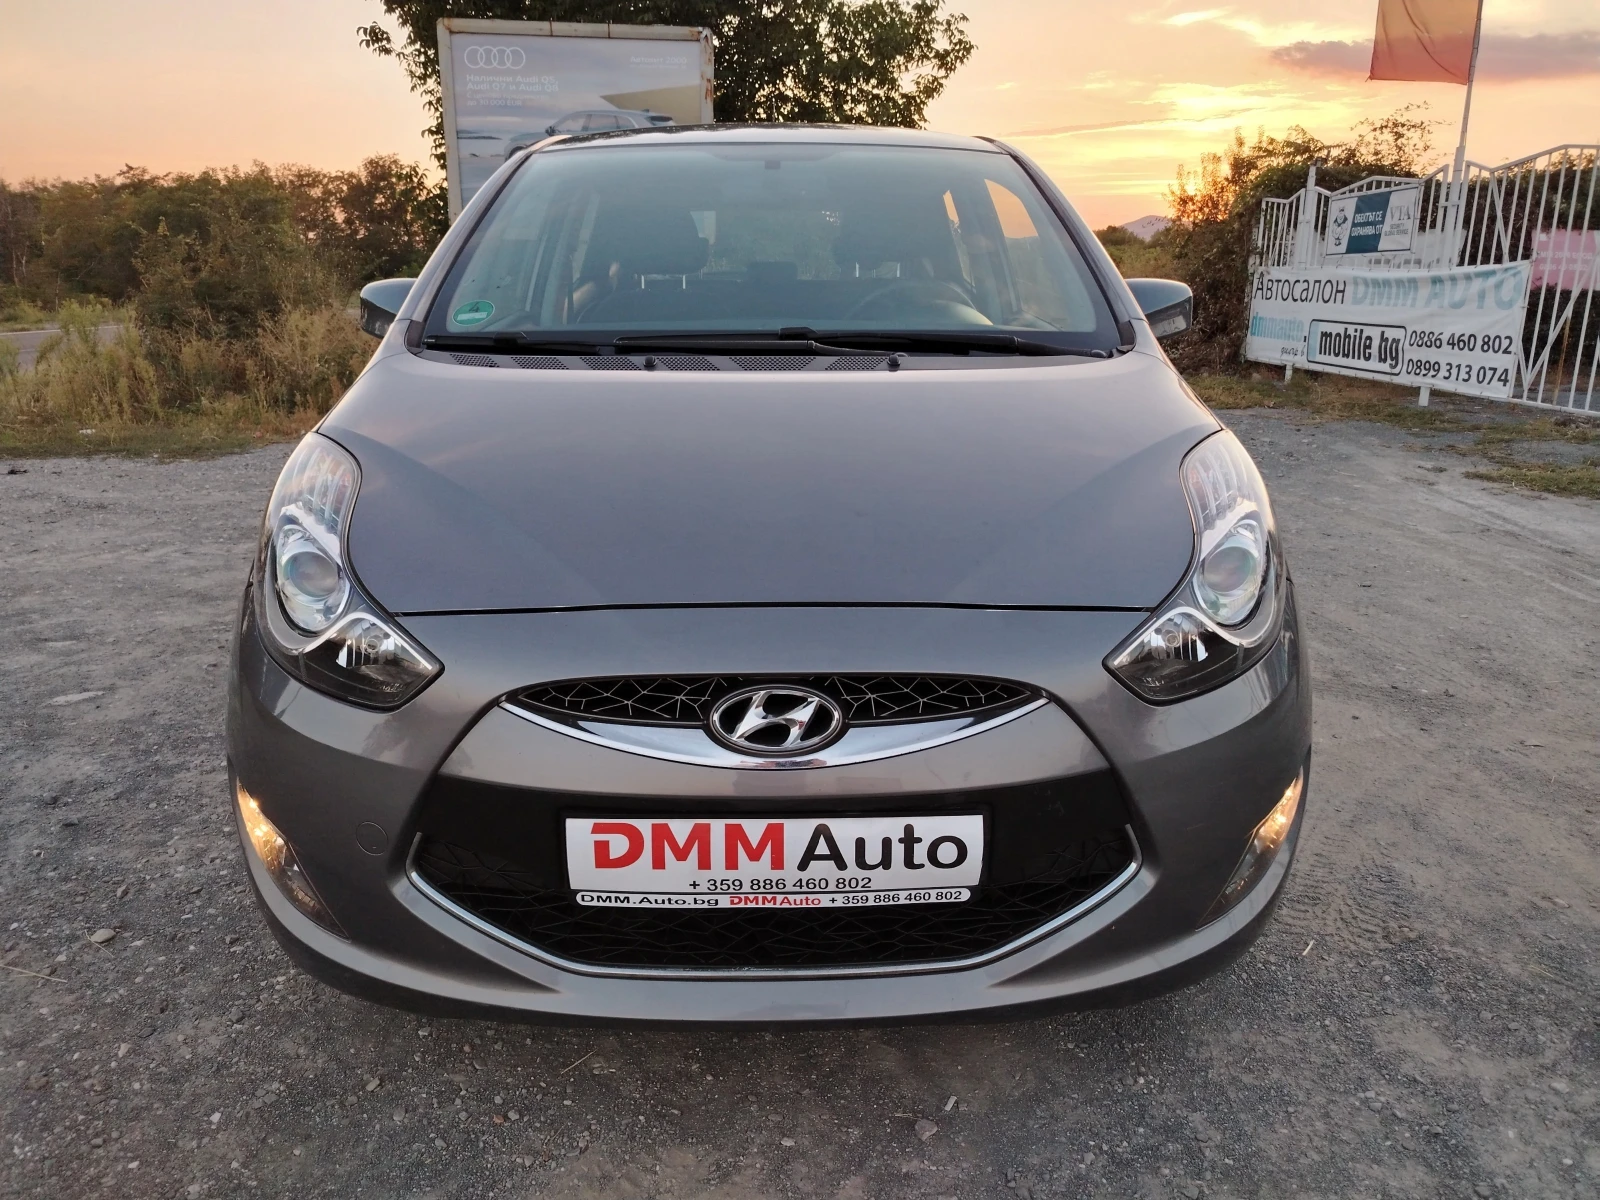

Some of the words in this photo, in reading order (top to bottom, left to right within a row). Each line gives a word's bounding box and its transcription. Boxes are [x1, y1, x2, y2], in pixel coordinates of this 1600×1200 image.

[466, 74, 513, 82] Налични
[516, 74, 538, 83] Audi
[466, 82, 490, 90] Audi
[492, 82, 506, 91] Q7
[519, 83, 542, 91] Audi
[1354, 212, 1376, 223] ОБЕКТЪТ
[1375, 211, 1383, 221] СЕ
[1351, 225, 1375, 237] ОХРАНЯВА
[1376, 224, 1384, 235] ОТ
[1253, 271, 1346, 304] Автосалон
[1351, 276, 1419, 307] DMM
[1424, 268, 1524, 310] AUTO
[1408, 330, 1444, 349] 0886
[1446, 333, 1477, 352] 460
[1480, 334, 1513, 355] 802
[1405, 358, 1441, 378] 0899
[1443, 362, 1473, 383] 313
[1476, 365, 1510, 387] 074
[590, 823, 785, 871] DMM
[796, 823, 968, 872] Auto
[707, 879, 743, 891] 359
[750, 879, 786, 891] 886
[792, 878, 829, 890] 460
[835, 877, 872, 889] 802
[580, 894, 719, 907] DMM.Auto.bg
[842, 895, 869, 905] 359
[873, 894, 900, 904] 886
[904, 893, 931, 903] 460
[935, 891, 963, 901] 802
